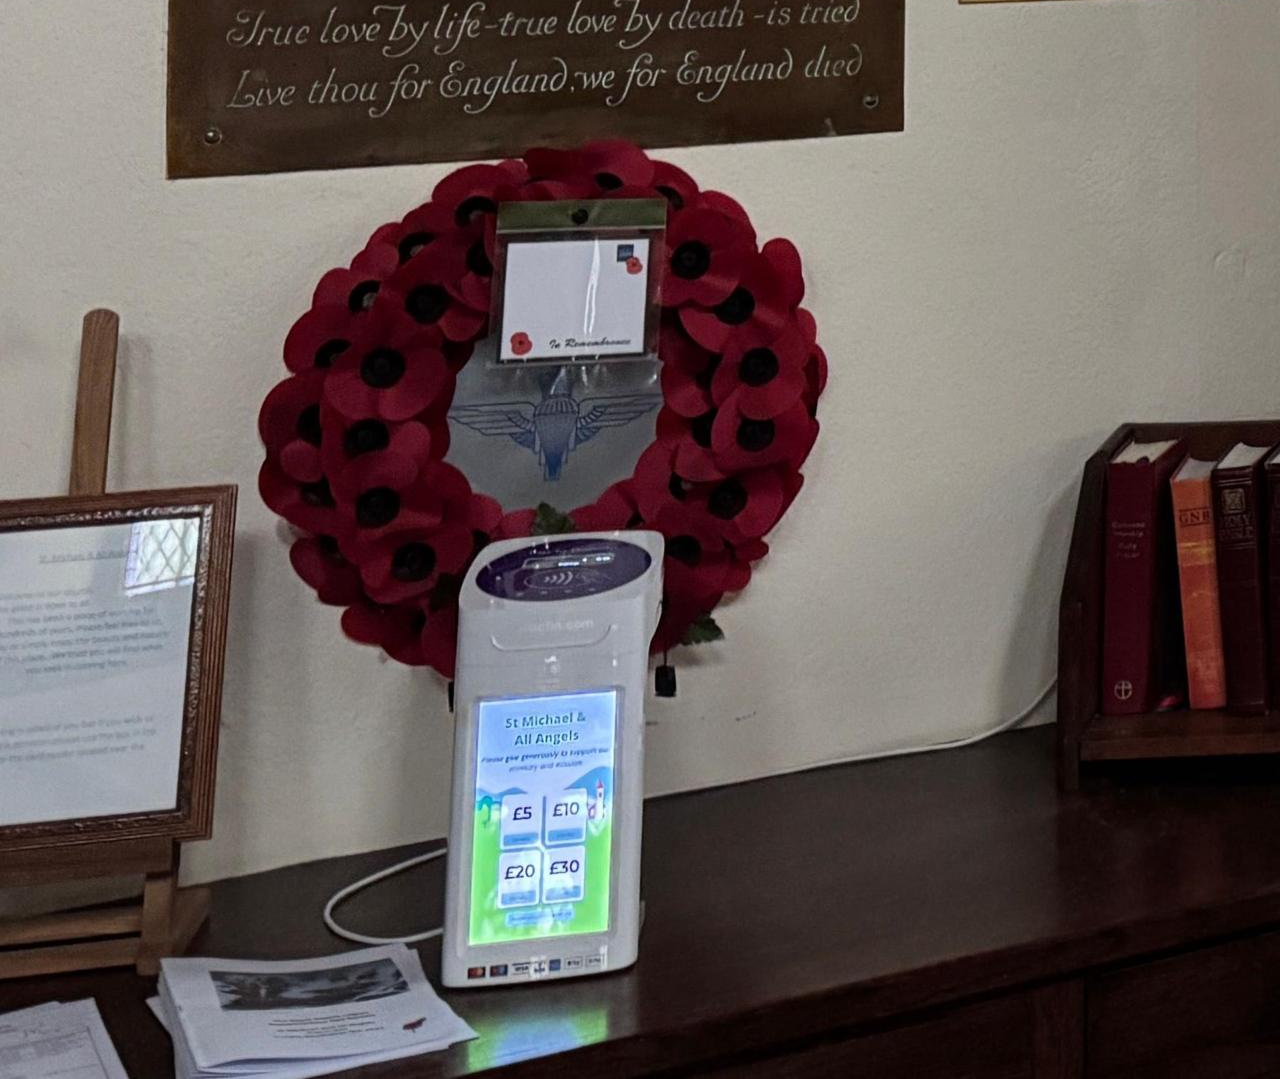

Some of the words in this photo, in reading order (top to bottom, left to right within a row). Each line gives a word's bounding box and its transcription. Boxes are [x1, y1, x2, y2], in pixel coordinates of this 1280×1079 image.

[226, 9, 311, 50] True
[319, 5, 381, 45] love
[372, 3, 429, 58] by
[226, 69, 296, 108] Live
[308, 67, 378, 104] thou
[368, 63, 432, 119] for
[605, 52, 666, 107] for
[676, 48, 794, 104] England
[804, 42, 865, 78] died
[565, 338, 631, 348] Remembrance
[505, 718, 518, 728] St
[522, 713, 573, 727] Michael
[515, 735, 532, 745] All
[536, 730, 579, 745] Angels
[513, 807, 532, 821] £5
[553, 802, 579, 817] £10
[505, 864, 535, 880] £20
[549, 859, 579, 874] £30
